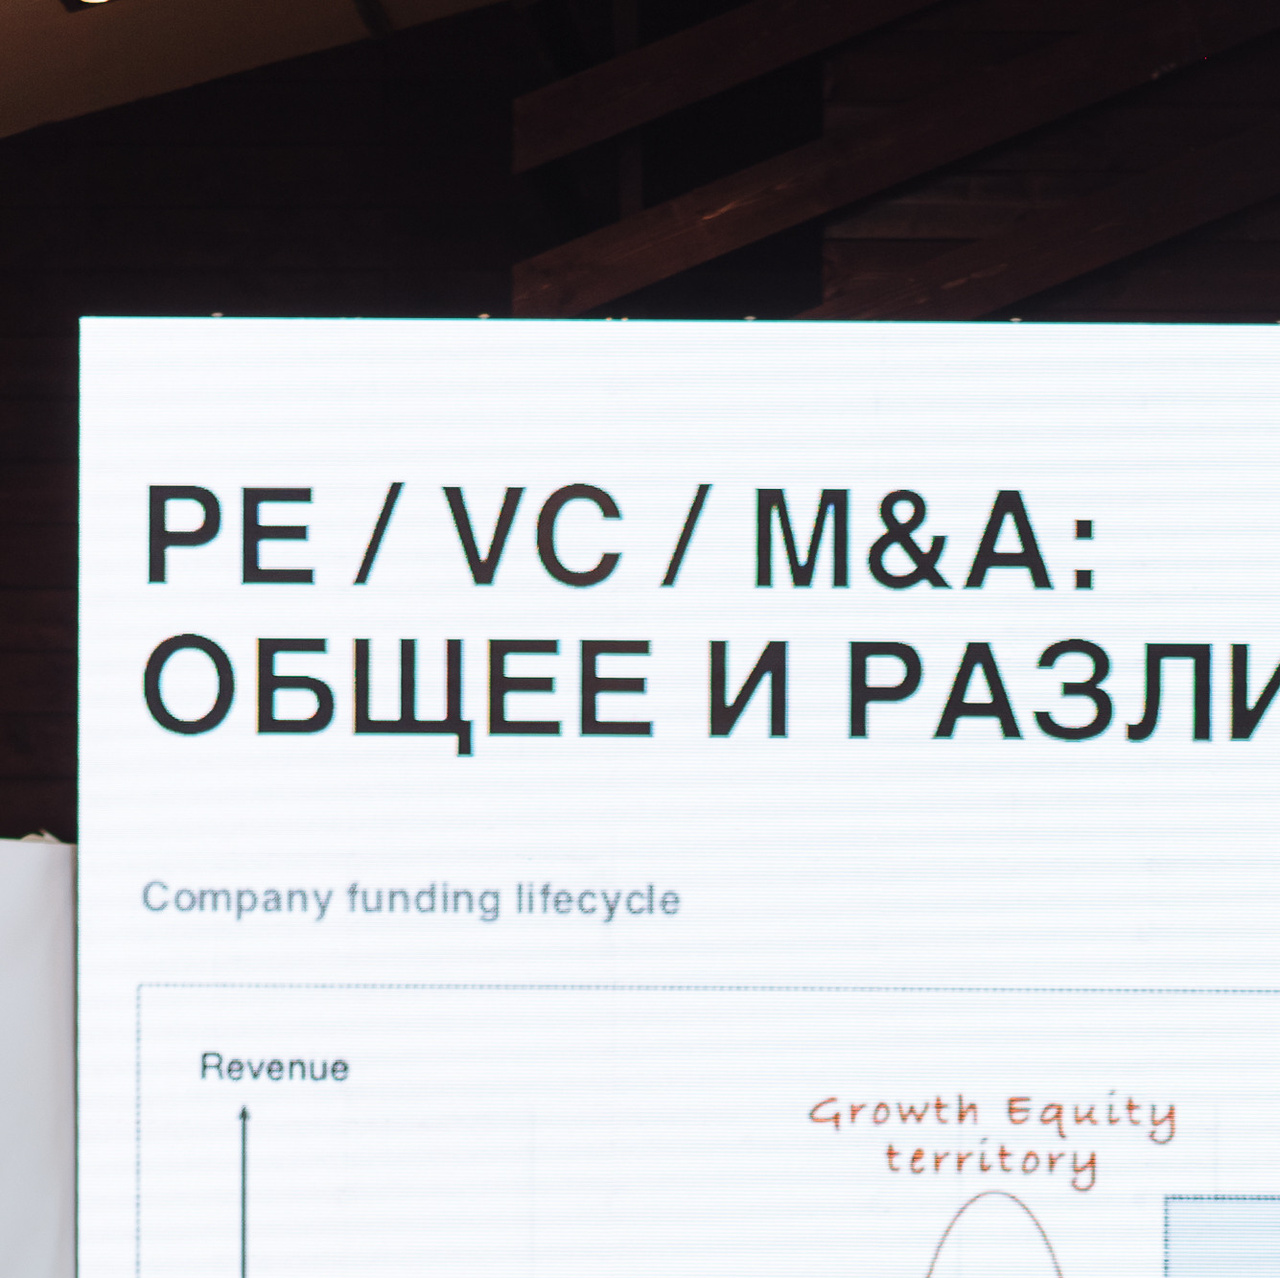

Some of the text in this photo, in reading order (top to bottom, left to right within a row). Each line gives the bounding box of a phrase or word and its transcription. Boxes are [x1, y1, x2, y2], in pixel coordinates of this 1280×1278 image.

[148, 481, 1095, 591] PE / VC / M&A:
[143, 632, 655, 758] ОБЩЕЕ
[708, 640, 790, 739] И
[141, 880, 682, 924] Company funding lifecycle
[200, 1051, 351, 1083] Revenue
[807, 1090, 1178, 1145] Growth Equity
[885, 1137, 1098, 1192] territory
